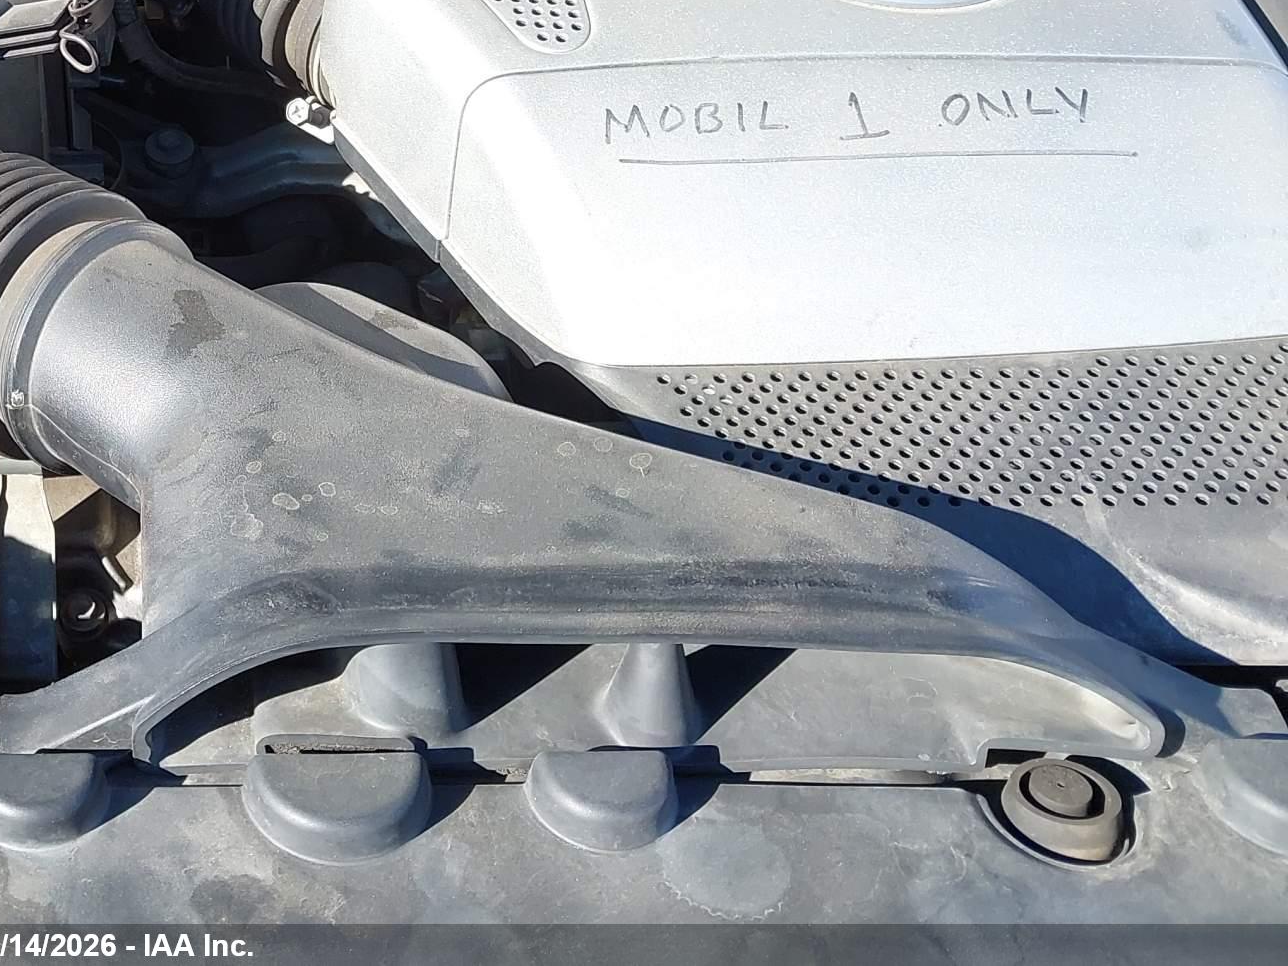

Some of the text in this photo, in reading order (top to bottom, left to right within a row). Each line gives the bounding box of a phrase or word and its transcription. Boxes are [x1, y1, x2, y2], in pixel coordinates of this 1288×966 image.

[604, 86, 1090, 144] MOBIL 1 ONLY
